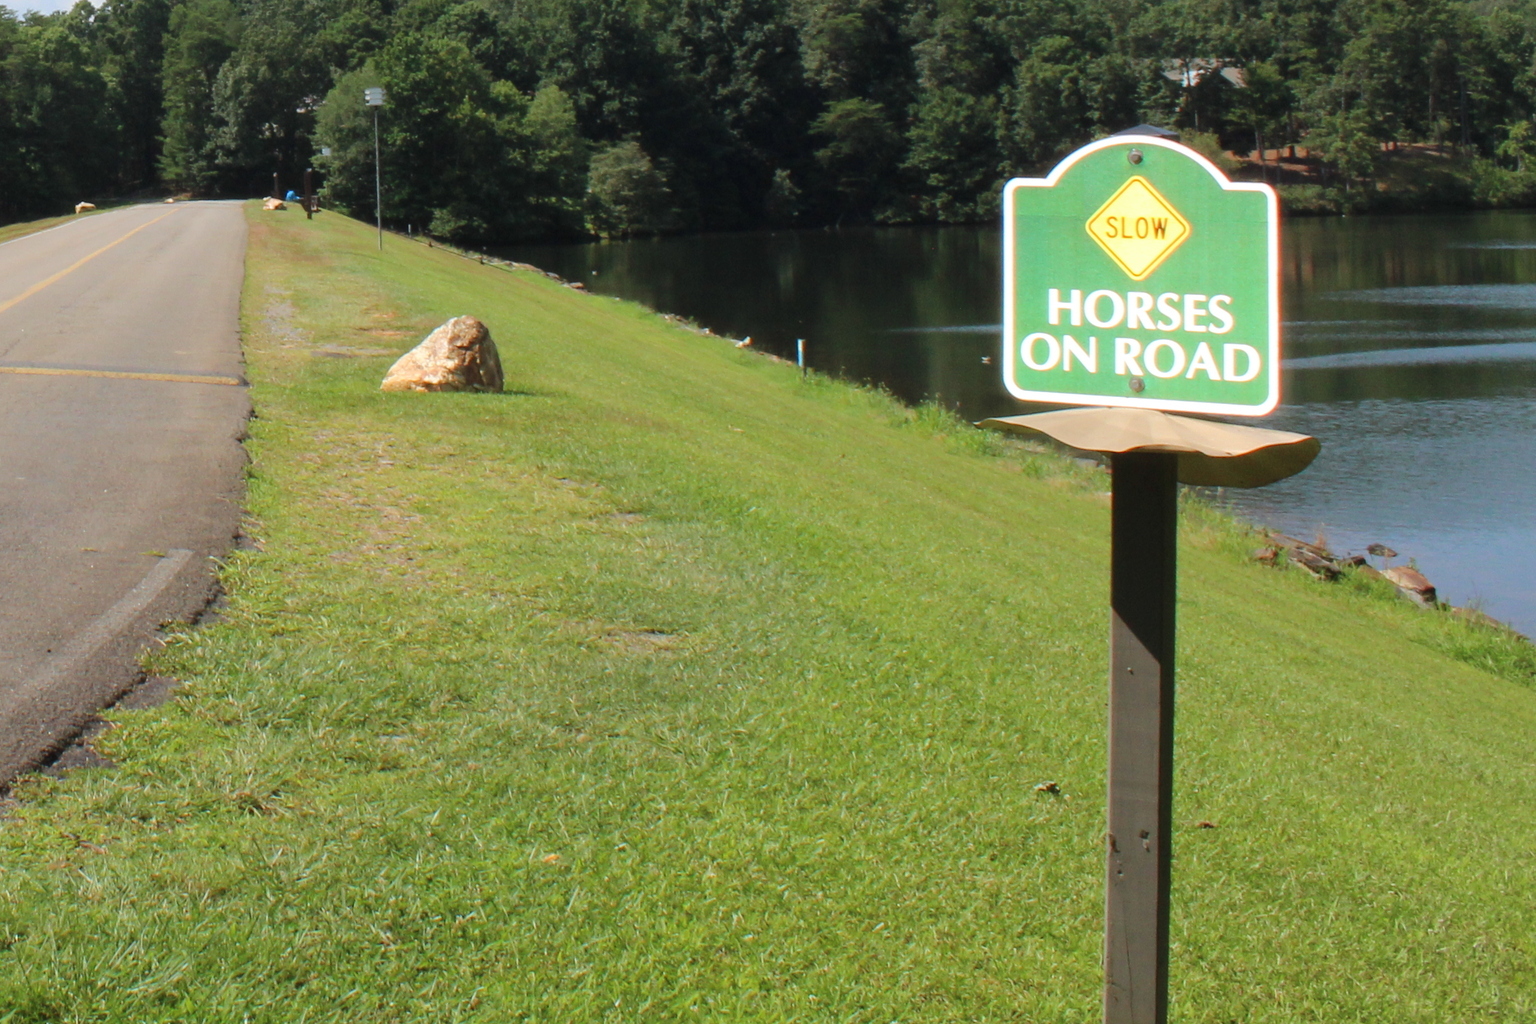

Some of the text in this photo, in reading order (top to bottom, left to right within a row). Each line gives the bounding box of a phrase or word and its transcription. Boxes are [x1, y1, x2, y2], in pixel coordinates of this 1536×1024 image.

[1105, 216, 1168, 240] SLOW
[1047, 288, 1234, 334] HORSES
[1020, 332, 1261, 383] ON ROAD
